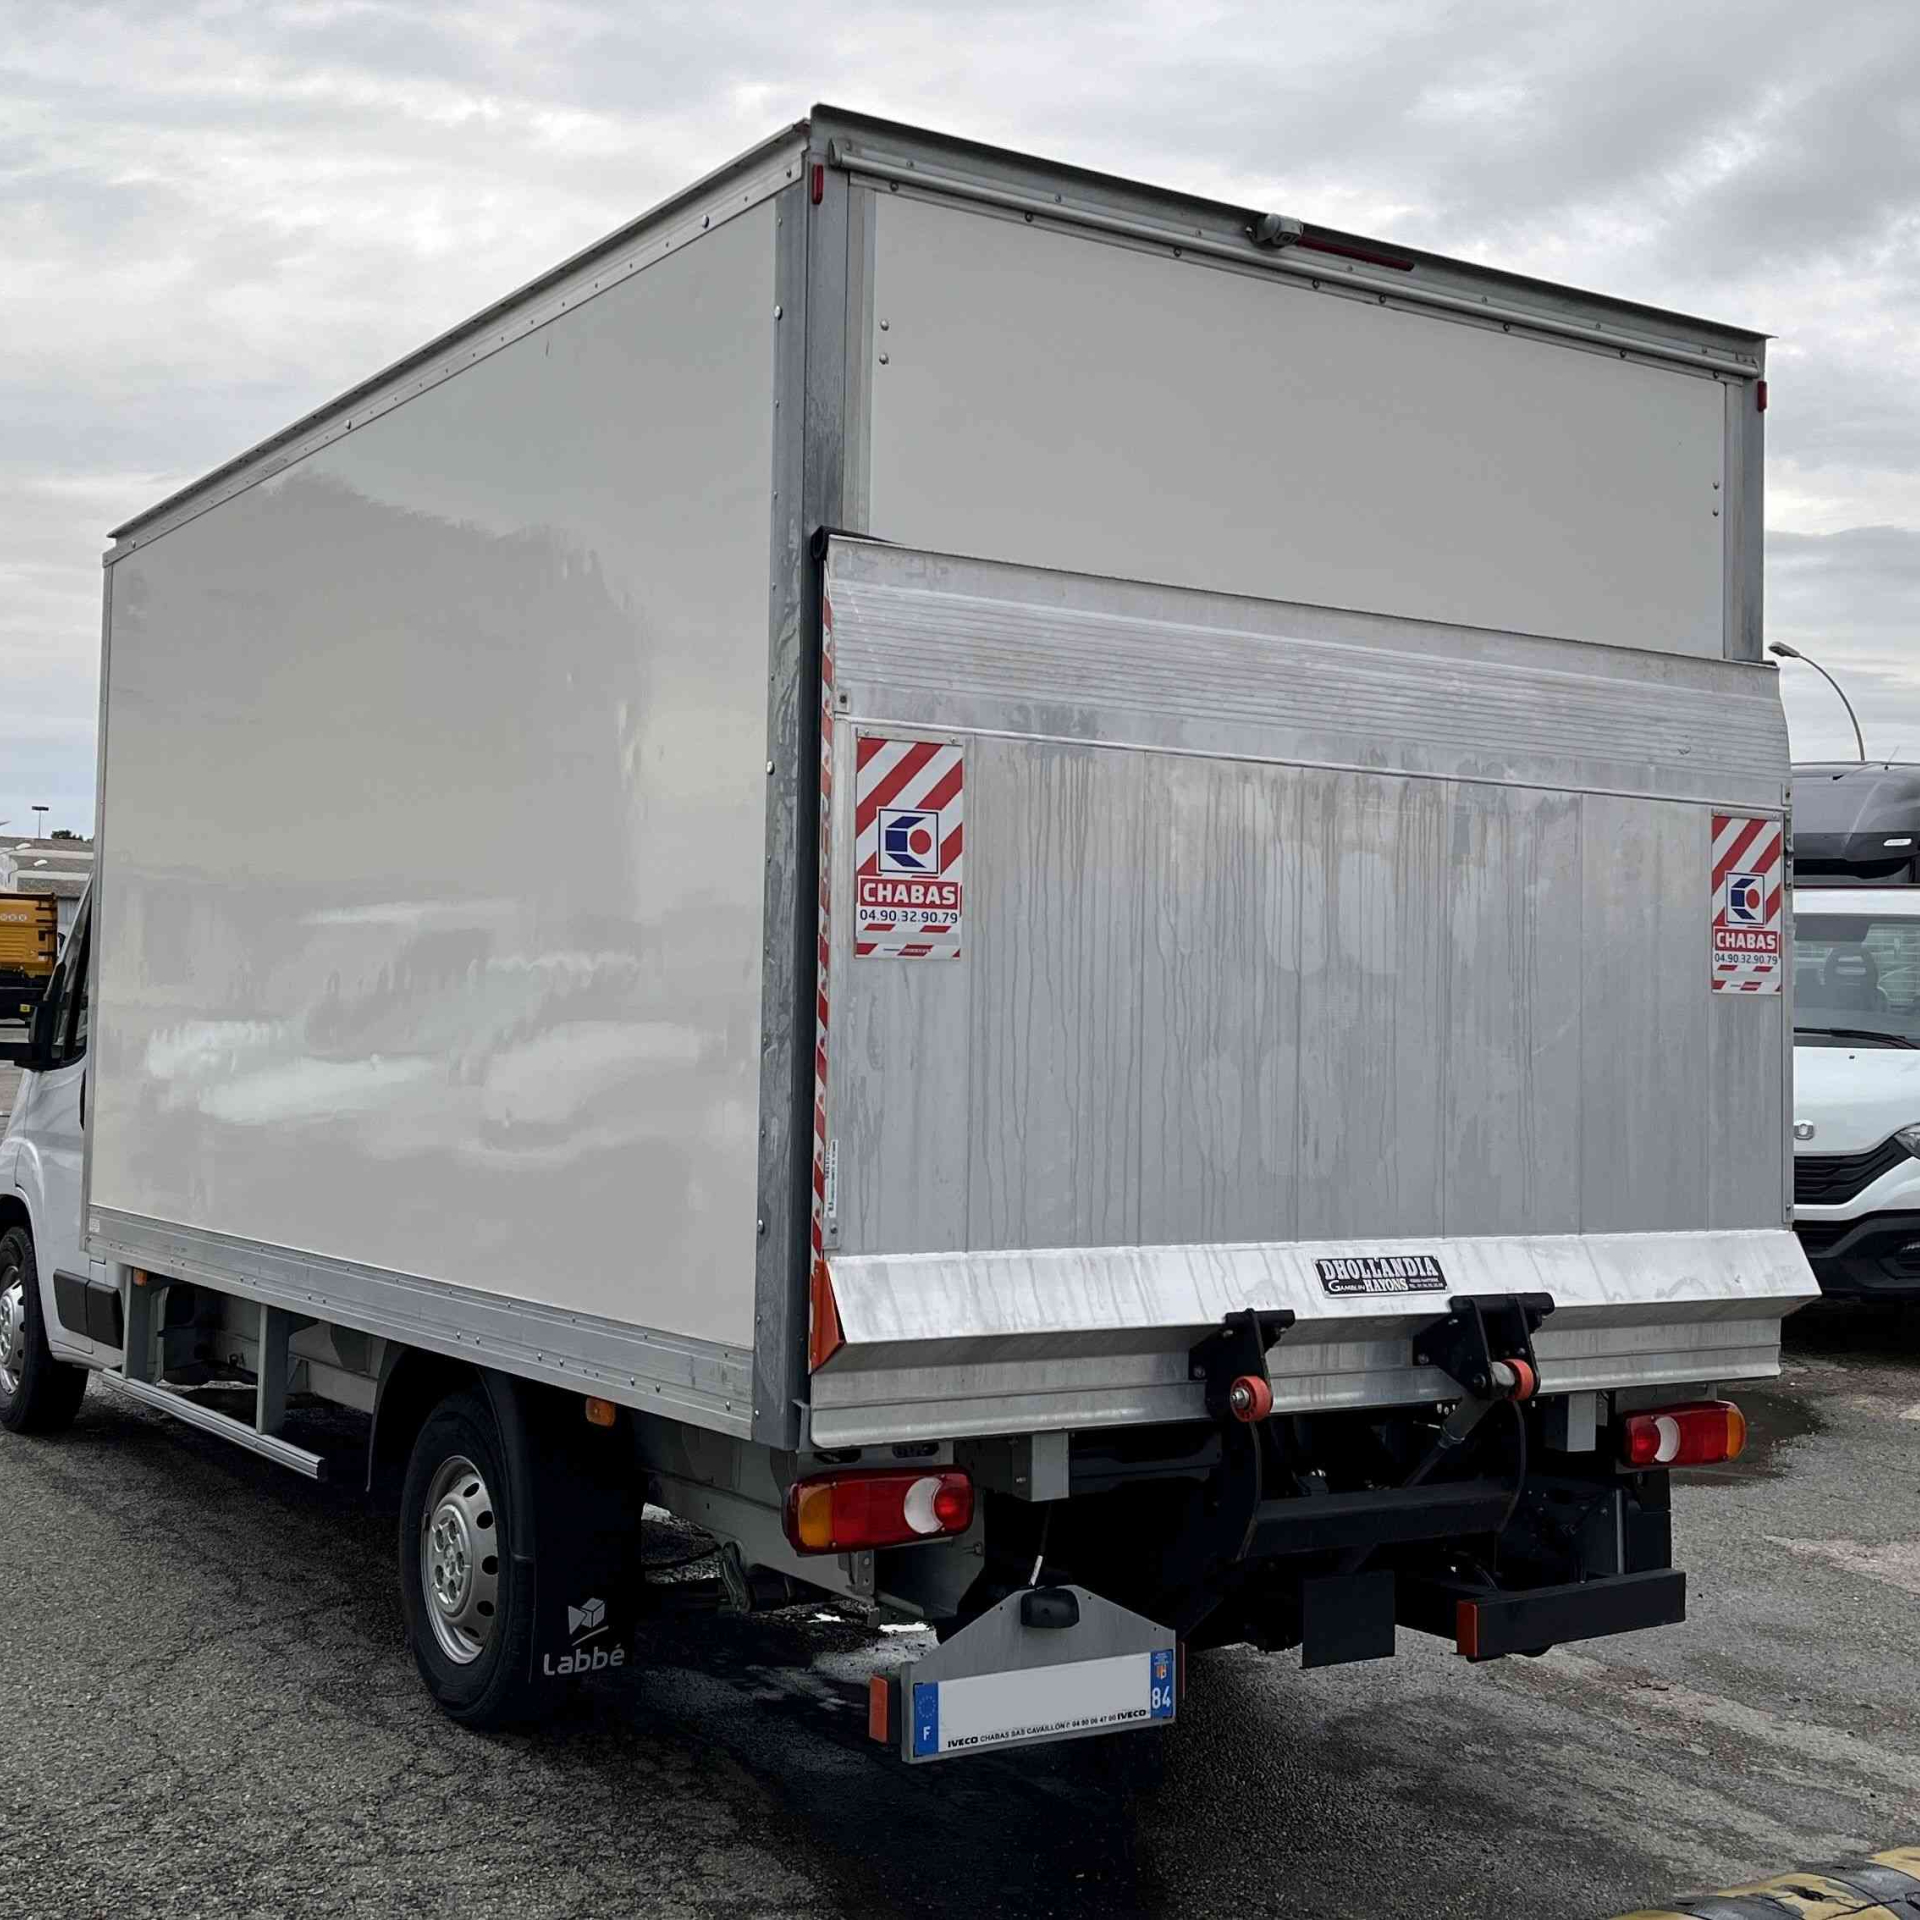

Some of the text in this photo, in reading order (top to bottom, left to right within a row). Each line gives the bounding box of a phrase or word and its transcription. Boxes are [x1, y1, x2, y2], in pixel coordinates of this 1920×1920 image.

[863, 882, 956, 905] CHABAS
[860, 909, 958, 924] 04.90.32.90.79
[1716, 932, 1776, 950] CHABAS
[1714, 953, 1778, 965] 04.90.32.90.79
[1320, 1257, 1439, 1280] DHOLLANDIA
[1364, 1278, 1409, 1292] HAYONS
[1151, 1685, 1171, 1709] 84
[923, 1726, 931, 1741] F
[947, 1736, 979, 1748] IVECO
[1117, 1709, 1147, 1721] IVECO
